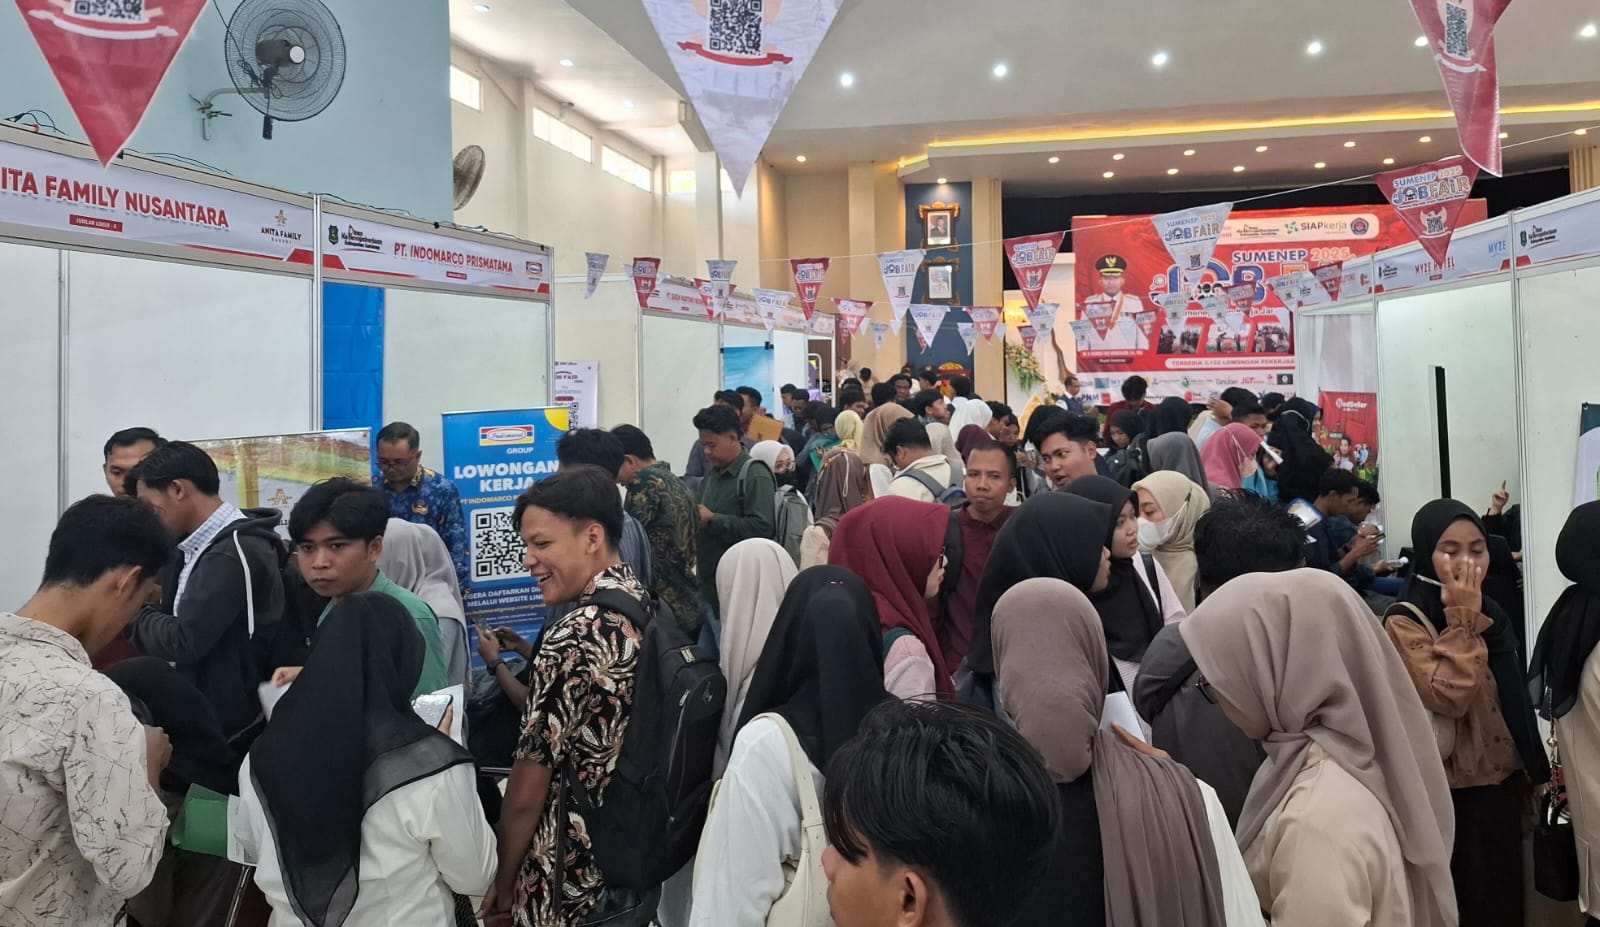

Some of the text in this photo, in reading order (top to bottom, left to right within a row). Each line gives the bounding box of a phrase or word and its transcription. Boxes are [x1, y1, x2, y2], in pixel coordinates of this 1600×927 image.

[1394, 171, 1437, 187] SUMENEP
[45, 175, 119, 208] FAMILY
[125, 191, 229, 228] NUSANTARA
[261, 226, 279, 237] ANITA
[280, 230, 302, 241] FAMILY
[410, 245, 463, 265] INDOMARCO
[466, 254, 512, 272] PRISMATAMA
[1233, 247, 1350, 262] SUMENEP 2025
[506, 447, 534, 455] GROUP
[454, 460, 559, 479] LOWONGAN
[480, 477, 534, 493] KERJA
[469, 495, 512, 505] INDOMARCO
[488, 587, 530, 598] DAFTARKAN
[499, 596, 528, 604] WEBSITE
